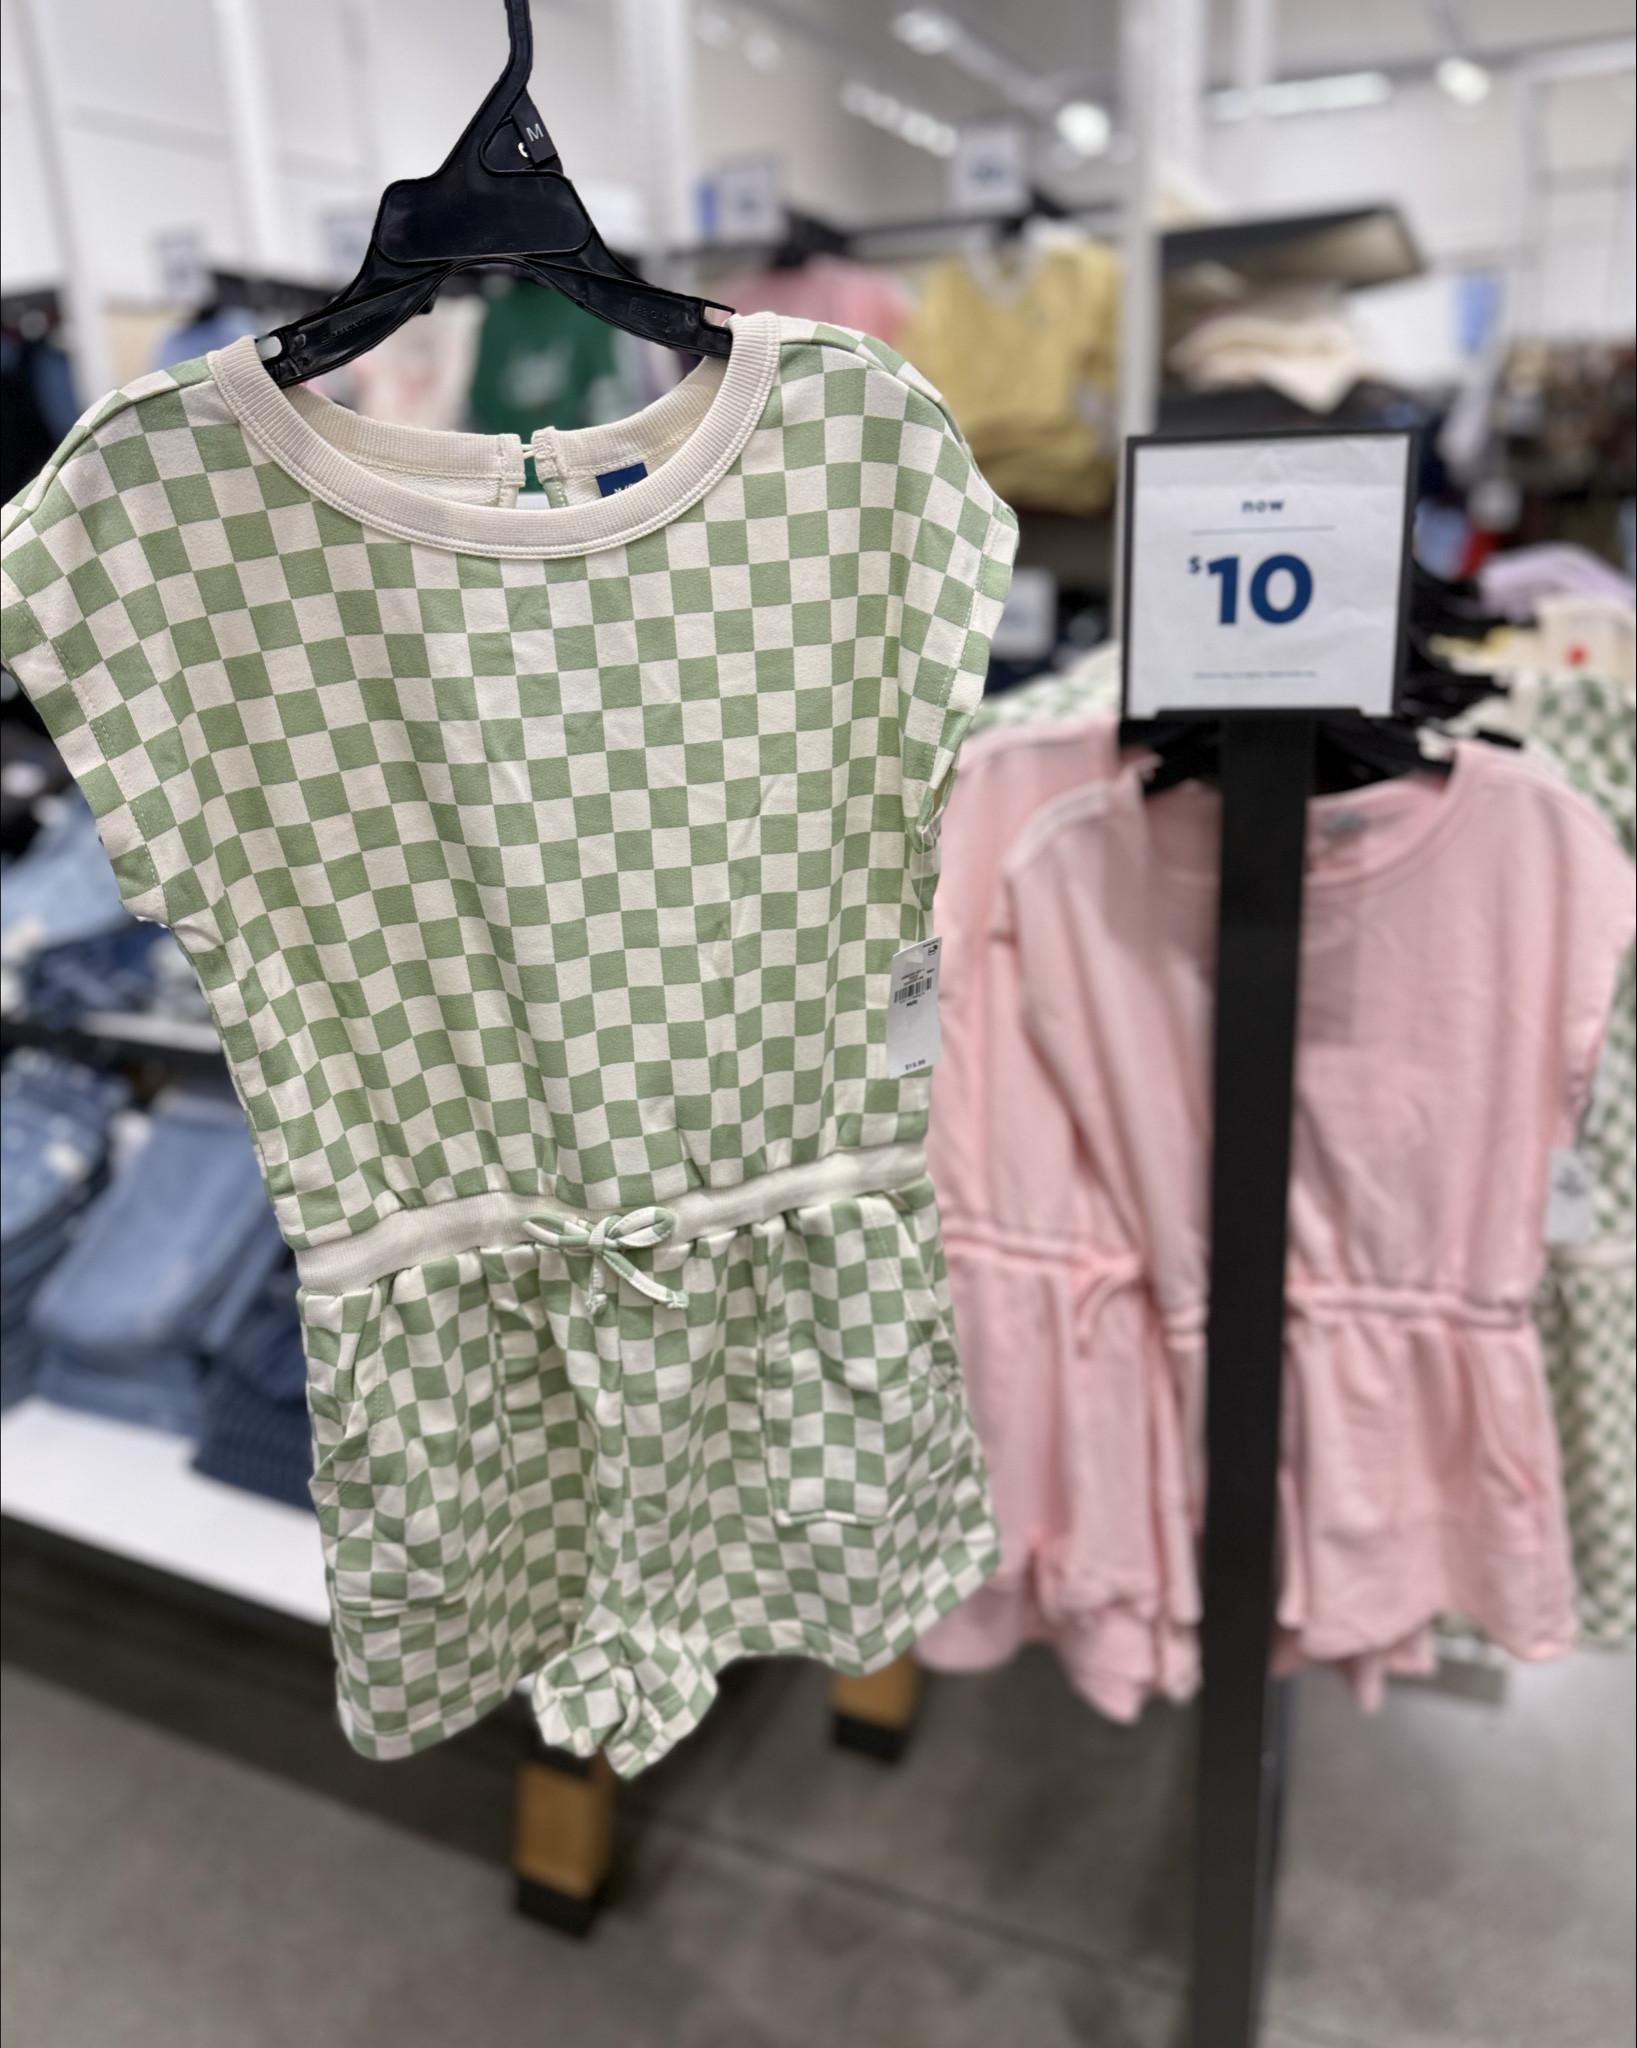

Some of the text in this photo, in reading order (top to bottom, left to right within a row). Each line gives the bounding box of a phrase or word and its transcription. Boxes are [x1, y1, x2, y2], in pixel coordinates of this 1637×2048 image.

[526, 123, 544, 142] M
[1241, 499, 1285, 515] now
[1188, 553, 1314, 626] $10
